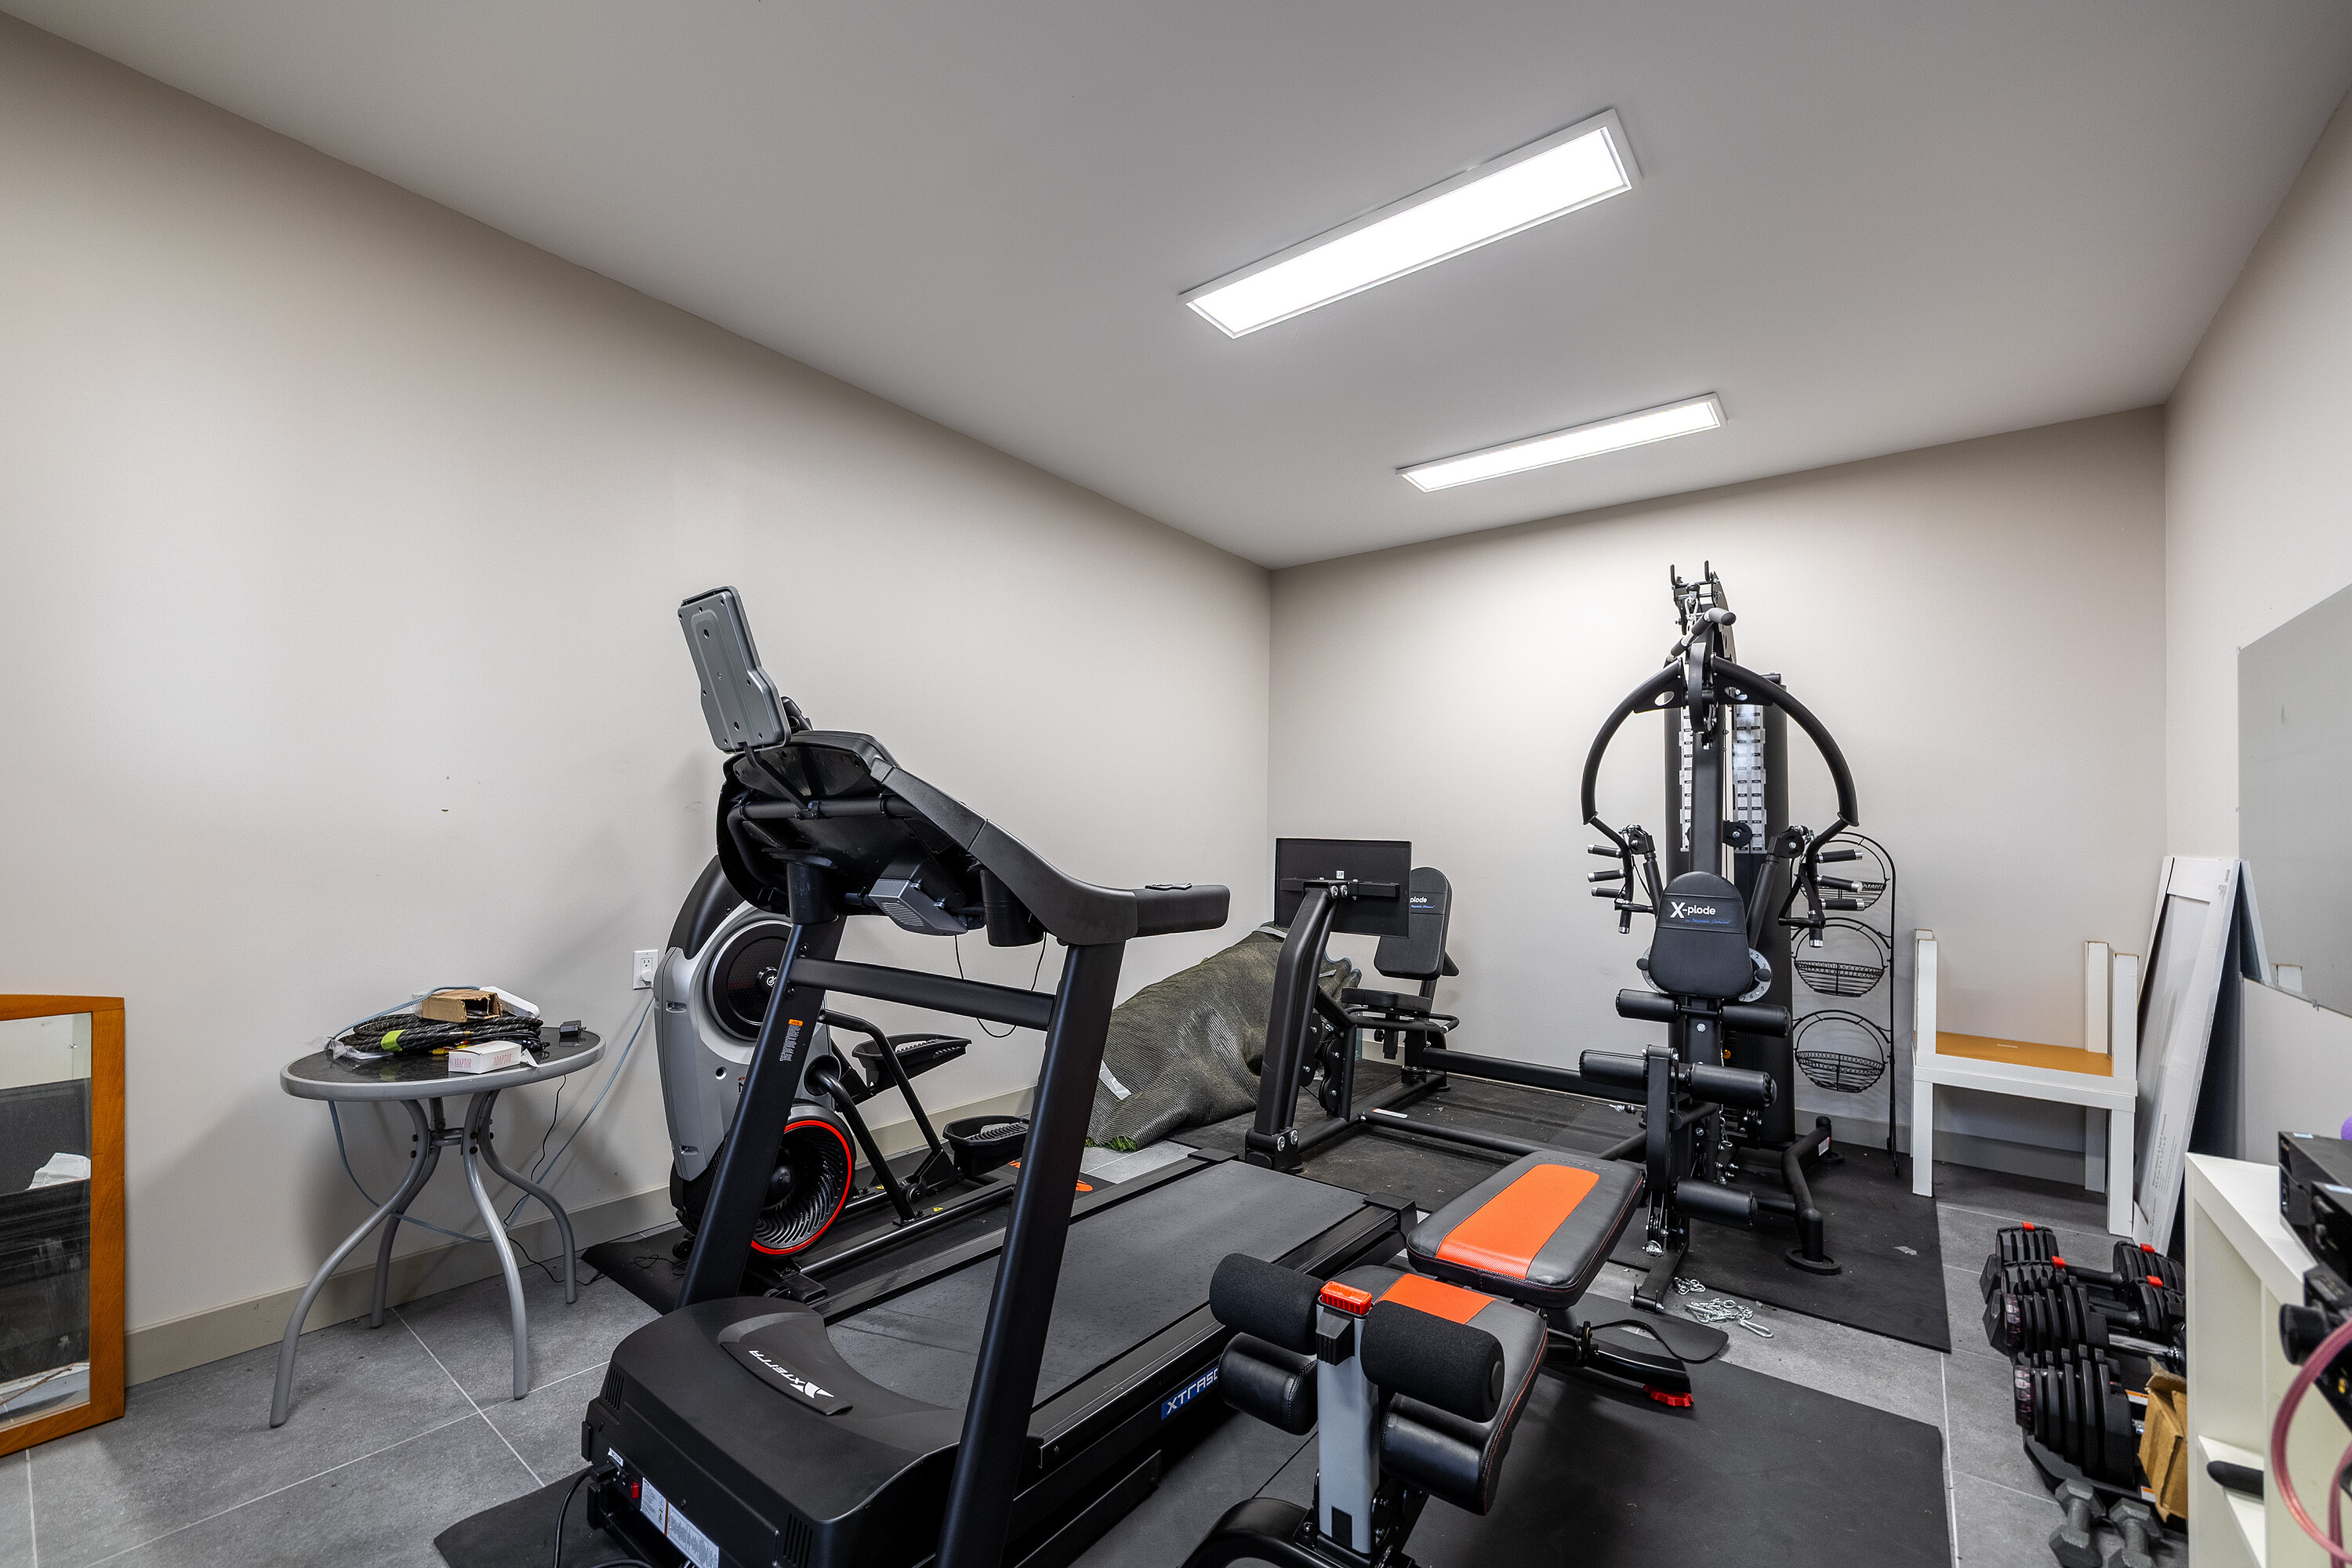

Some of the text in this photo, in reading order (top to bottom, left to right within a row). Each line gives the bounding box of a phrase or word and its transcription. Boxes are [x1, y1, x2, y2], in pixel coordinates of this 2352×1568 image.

[1670, 902, 1716, 919] X-plode
[454, 1058, 472, 1069] ADAPTOR
[492, 1053, 512, 1067] ADAPTOR
